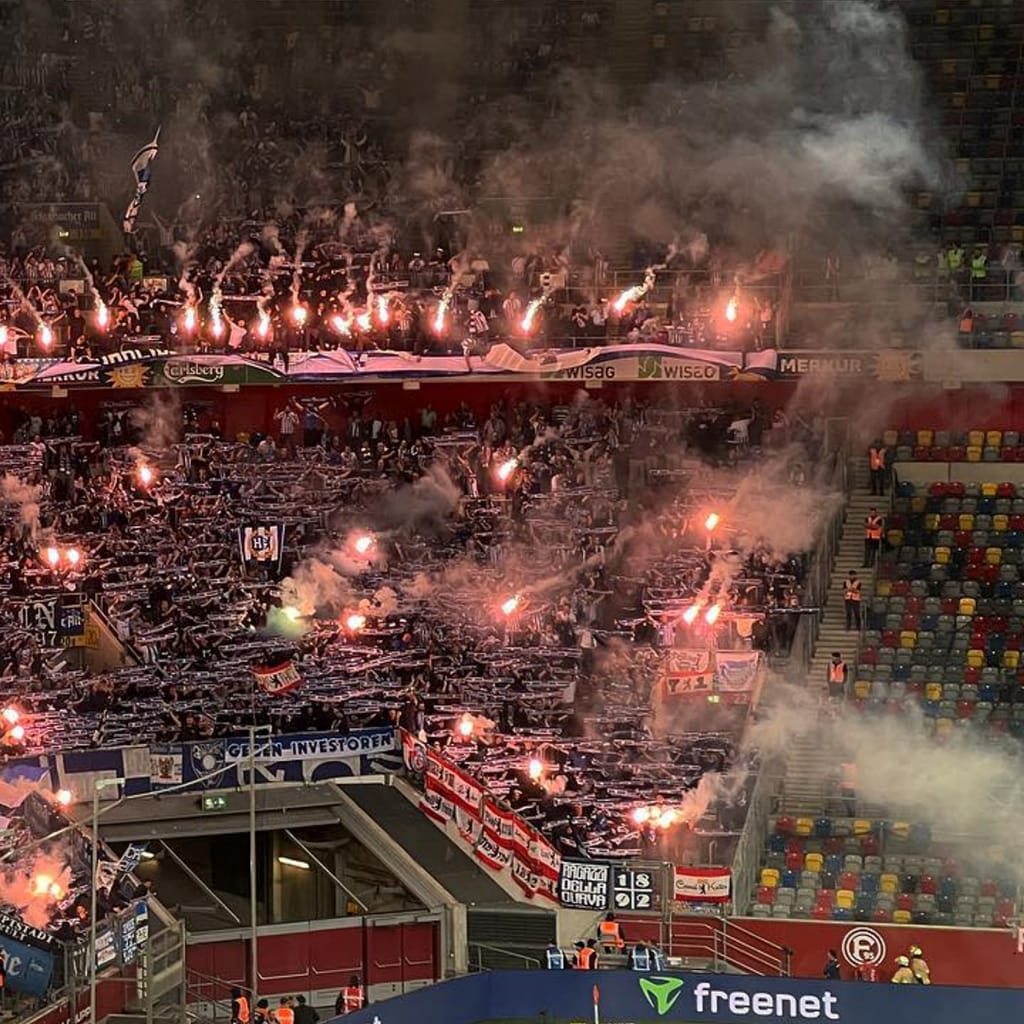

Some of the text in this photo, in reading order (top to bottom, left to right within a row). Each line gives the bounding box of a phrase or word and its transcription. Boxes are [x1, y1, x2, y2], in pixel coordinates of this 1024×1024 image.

[780, 359, 862, 372] MERKUR
[291, 733, 392, 755] INVESTOREN
[561, 878, 606, 893] DELLA
[694, 982, 839, 1020] freenet
